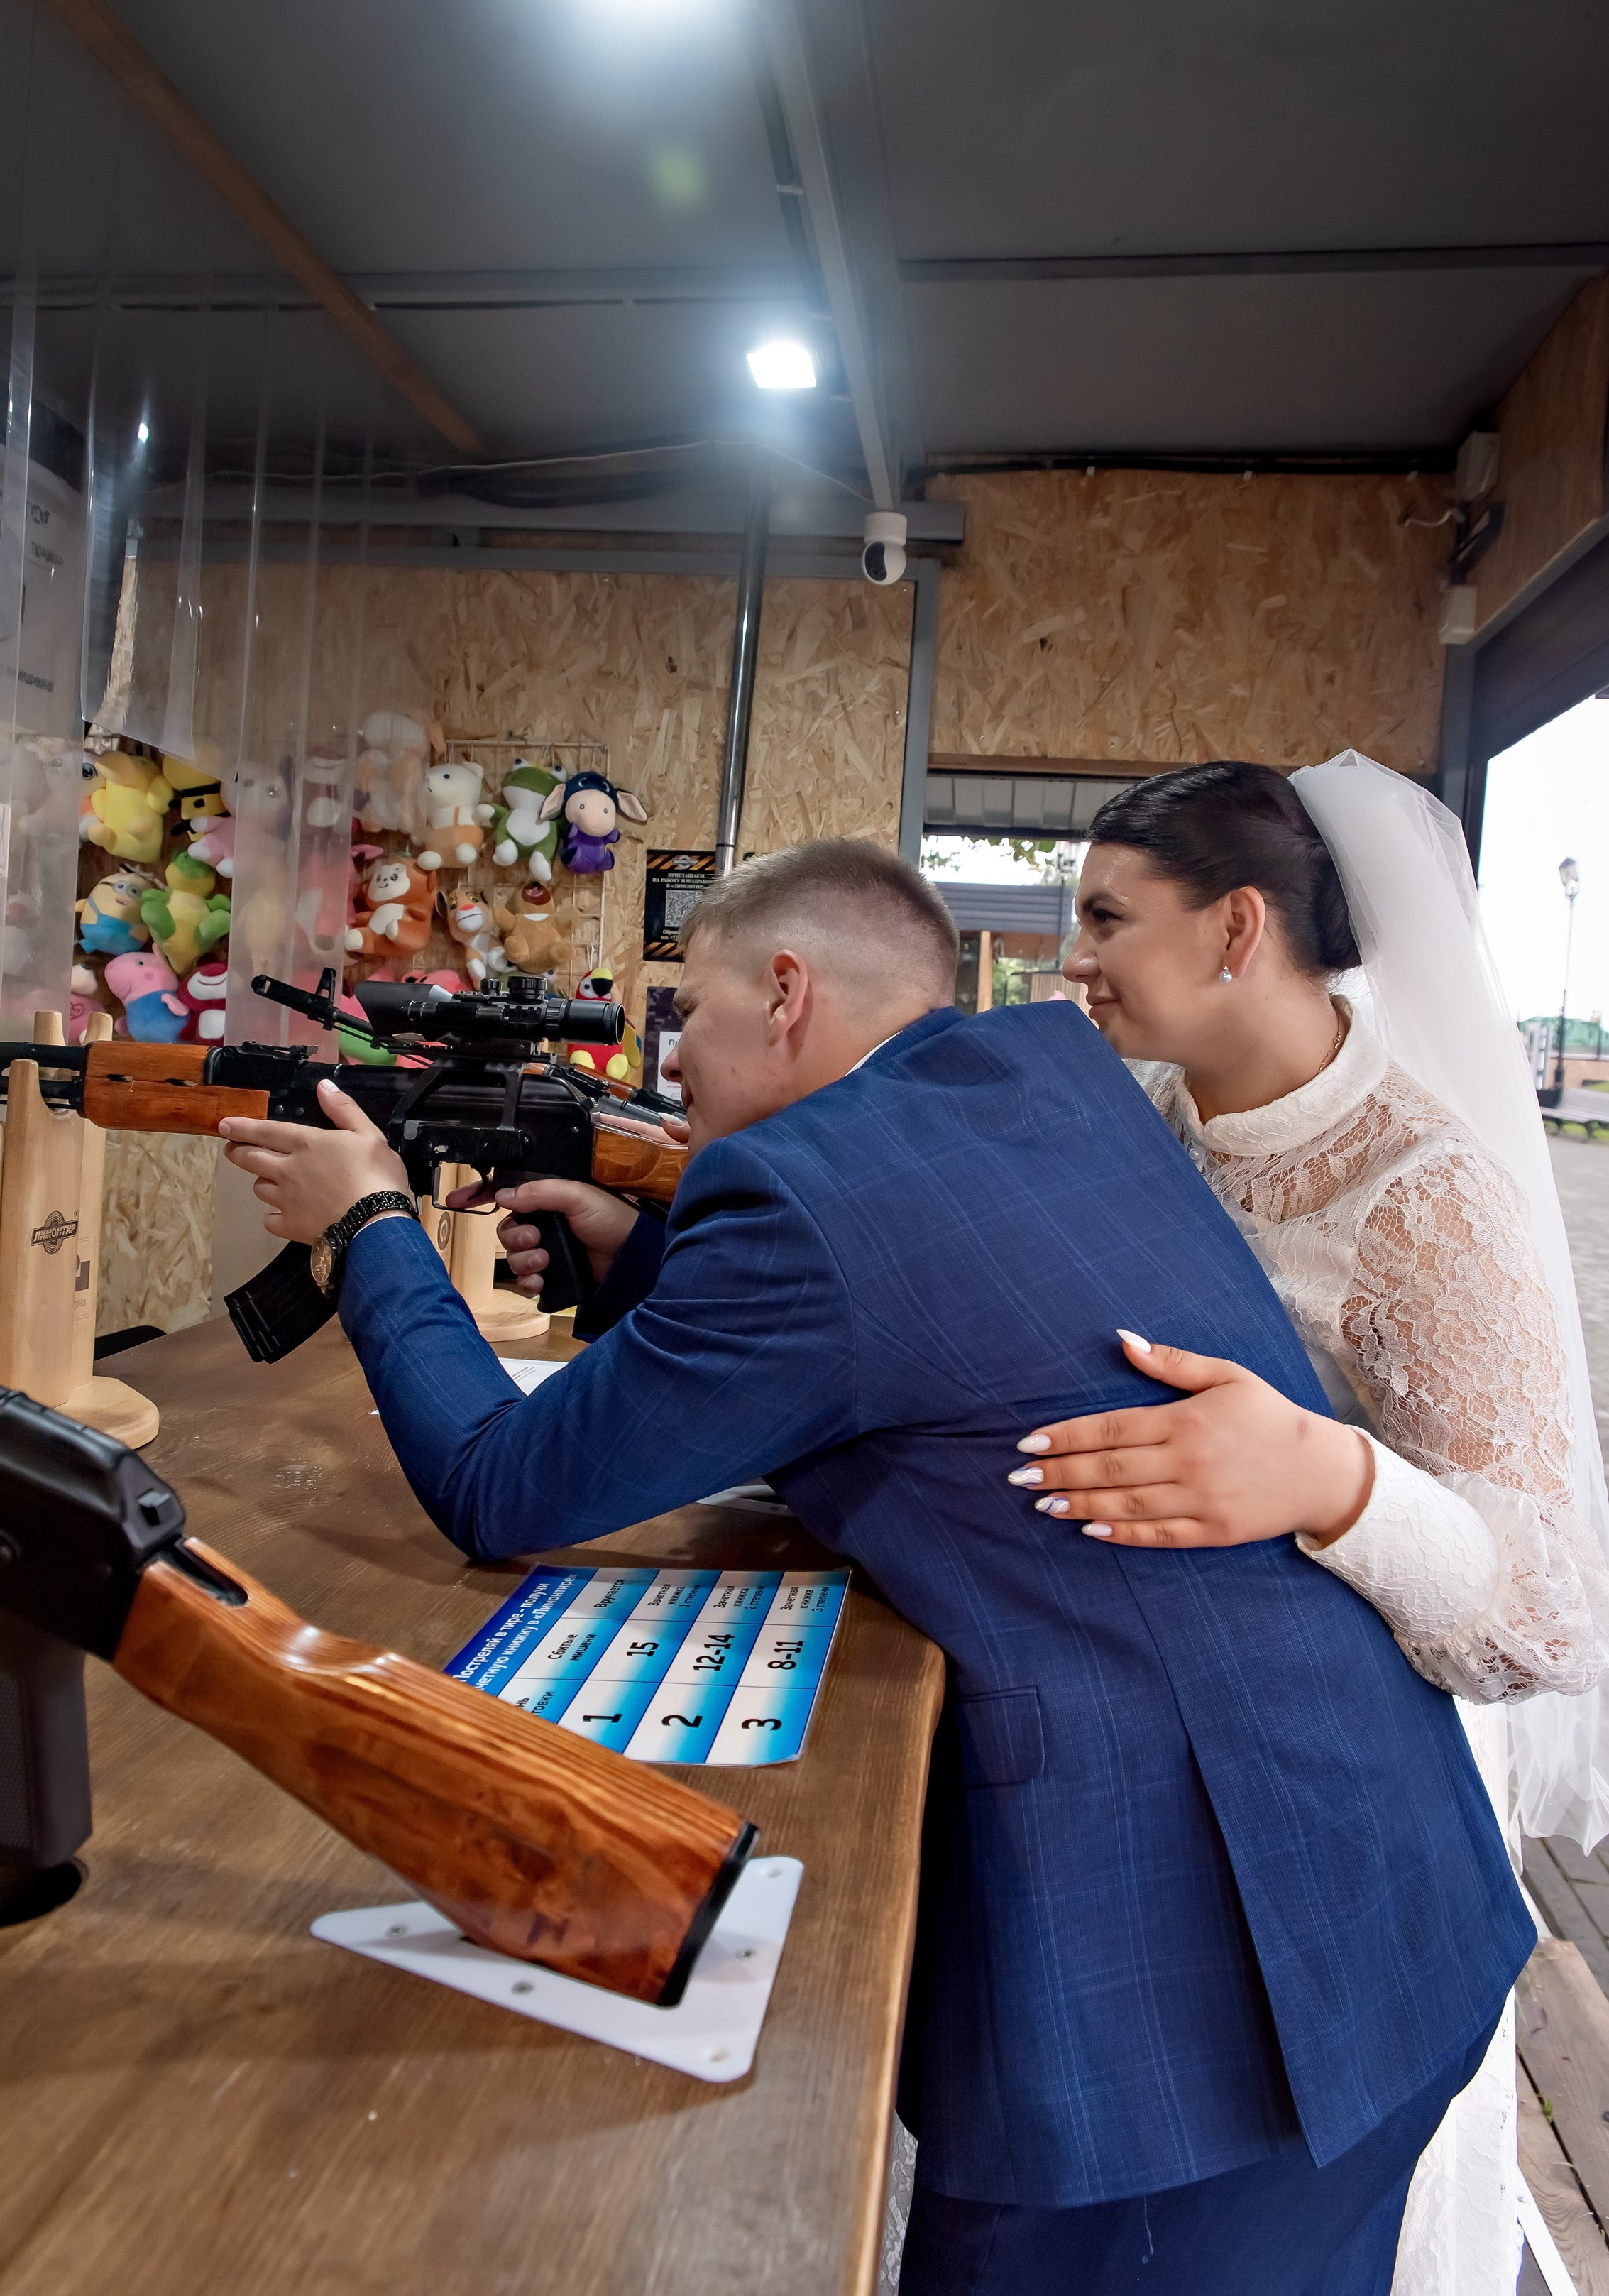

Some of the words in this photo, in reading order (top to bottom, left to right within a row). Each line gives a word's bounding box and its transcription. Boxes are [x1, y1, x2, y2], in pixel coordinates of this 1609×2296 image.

[33, 1223, 77, 1242] ЛИМОНТИР
[593, 1579, 625, 1608] Вручается
[647, 1584, 672, 1607] Зачетная
[668, 1586, 686, 1605] книжка
[684, 1584, 702, 1604] степени
[713, 1585, 735, 1608] Зачетная
[733, 1587, 750, 1607] книжка
[750, 1585, 766, 1606] степени
[780, 1587, 800, 1611] Зачетная
[800, 1589, 814, 1609] книжка
[816, 1586, 830, 1608] степени
[501, 1625, 539, 1656] книжку
[532, 1573, 578, 1620] «Лимонтире»
[503, 1613, 523, 1629] тире
[520, 1583, 550, 1608] получи
[547, 1634, 578, 1660] Сбитые
[570, 1634, 597, 1661] мишени
[626, 1641, 659, 1657] 15
[693, 1634, 735, 1672] 12-14
[767, 1641, 804, 1671] 8-11
[582, 1713, 622, 1724] 1
[661, 1714, 703, 1729] 2
[741, 1717, 783, 1732] 3
